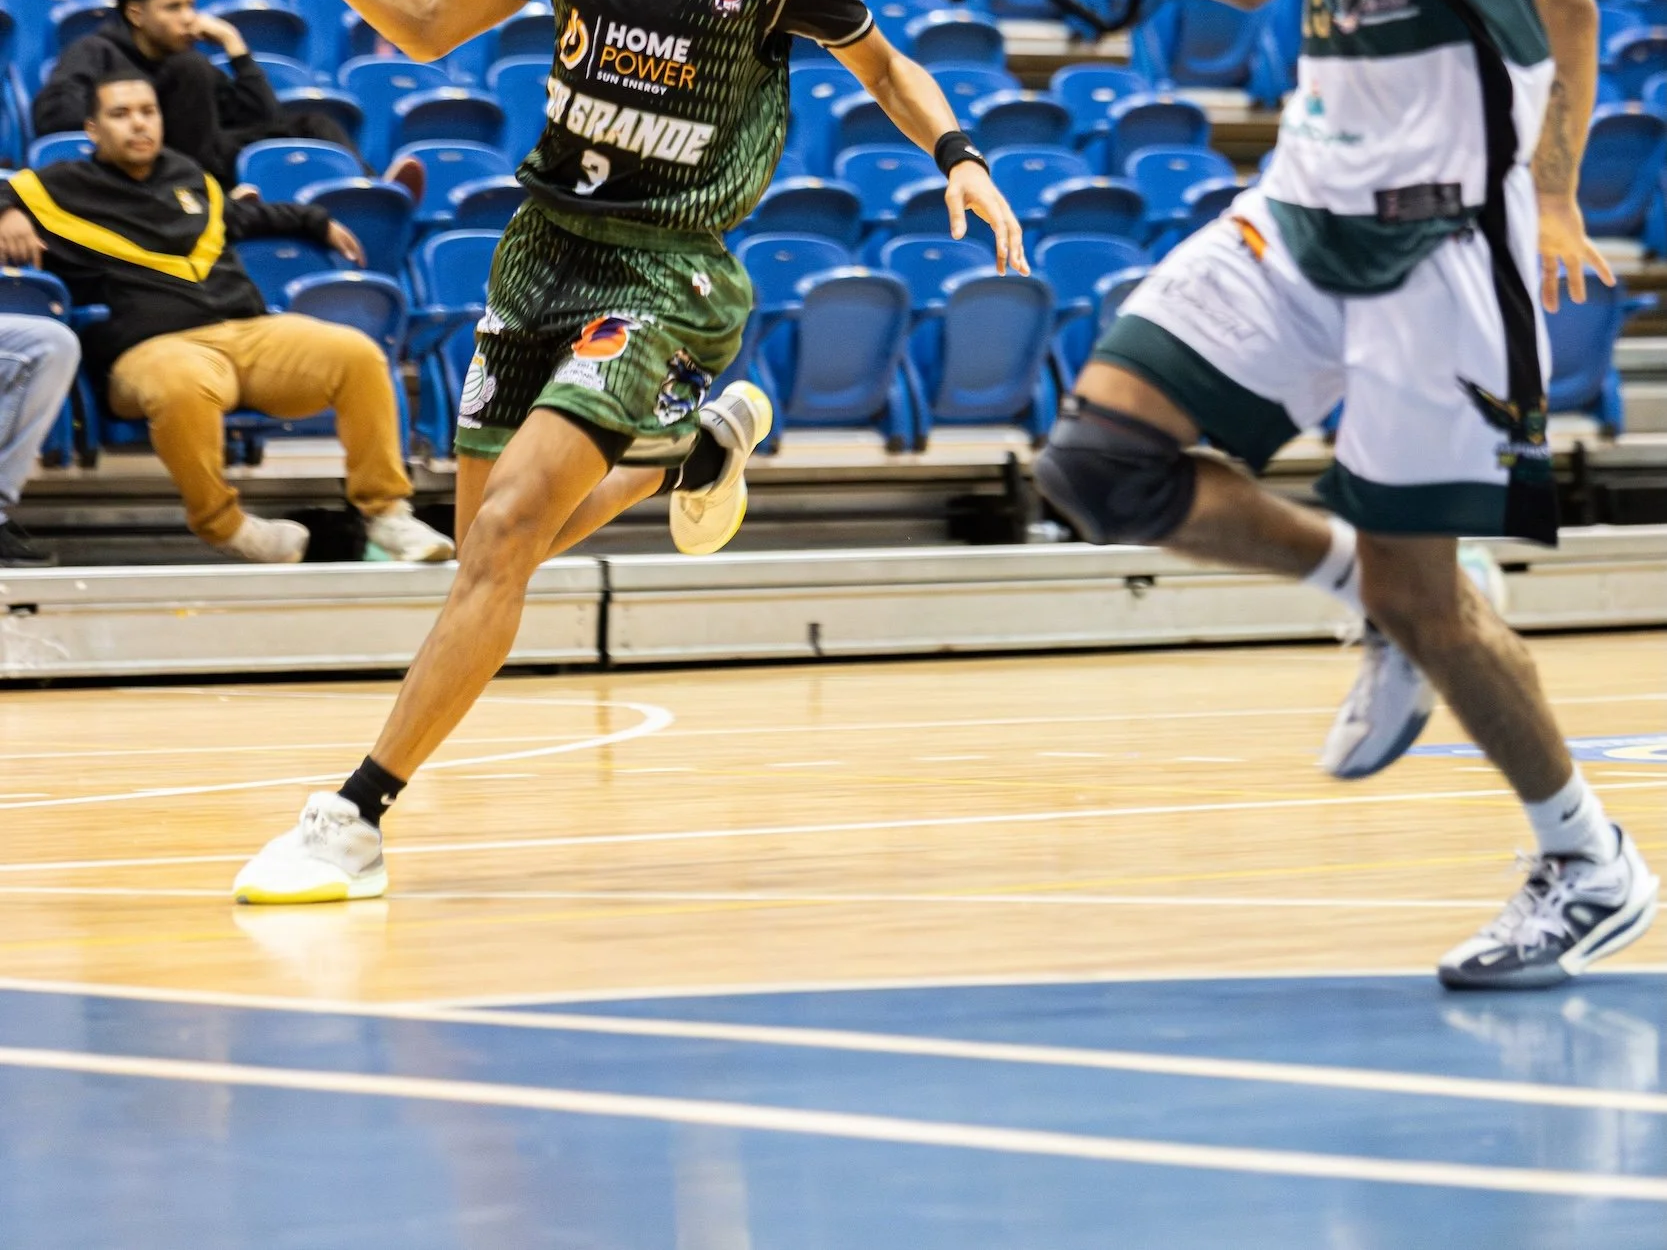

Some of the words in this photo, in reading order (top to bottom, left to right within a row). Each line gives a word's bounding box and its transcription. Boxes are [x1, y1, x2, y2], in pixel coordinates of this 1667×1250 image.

[605, 21, 692, 63] HOME
[596, 70, 620, 85] SUN
[622, 77, 668, 96] ENERGY
[599, 45, 697, 90] POWER
[566, 92, 717, 166] GRANDE
